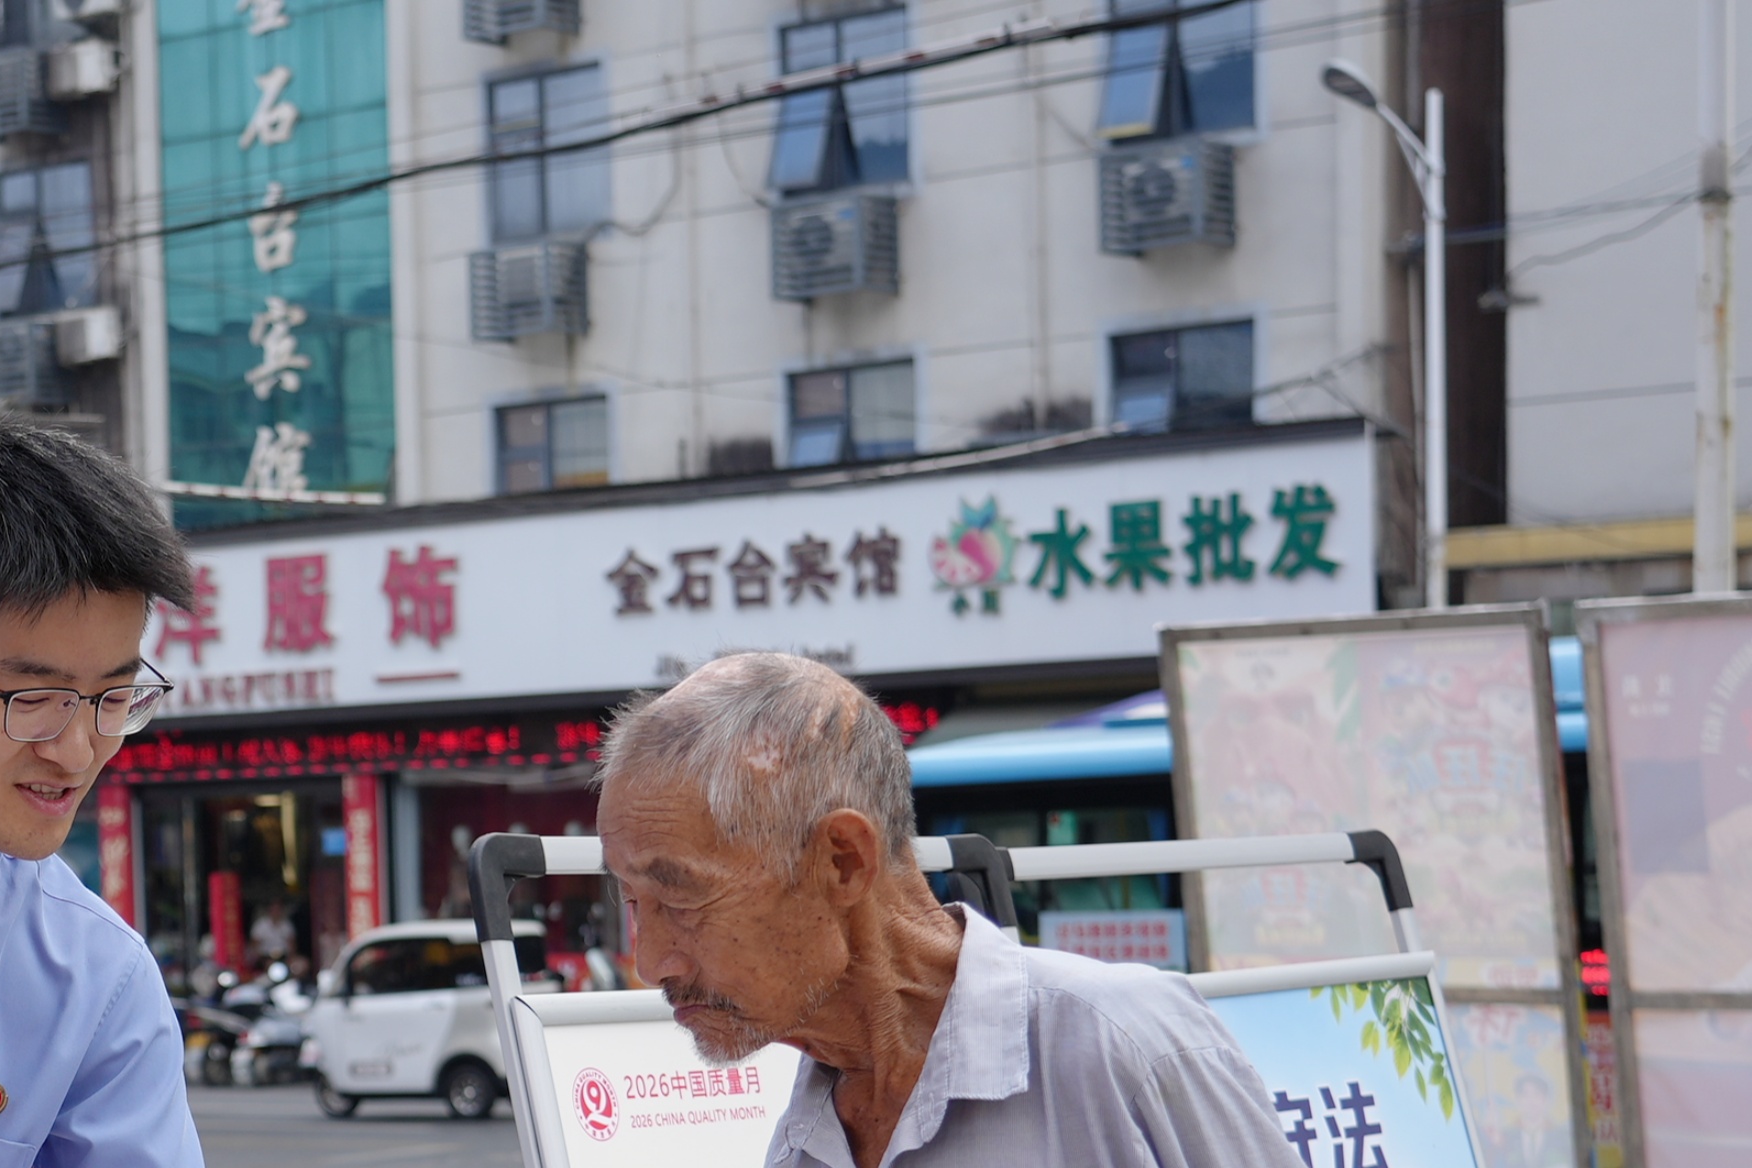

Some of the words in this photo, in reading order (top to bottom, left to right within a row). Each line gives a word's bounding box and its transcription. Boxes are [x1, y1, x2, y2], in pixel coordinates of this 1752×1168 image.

[605, 527, 901, 617] 金石台宾馆
[1029, 483, 1341, 599] 水果批发
[623, 1066, 761, 1100] 2026中国质量月
[630, 1115, 654, 1129] 2026
[655, 1112, 687, 1127] CHINA
[688, 1108, 727, 1125] QUALITY
[729, 1105, 766, 1121] MONTH
